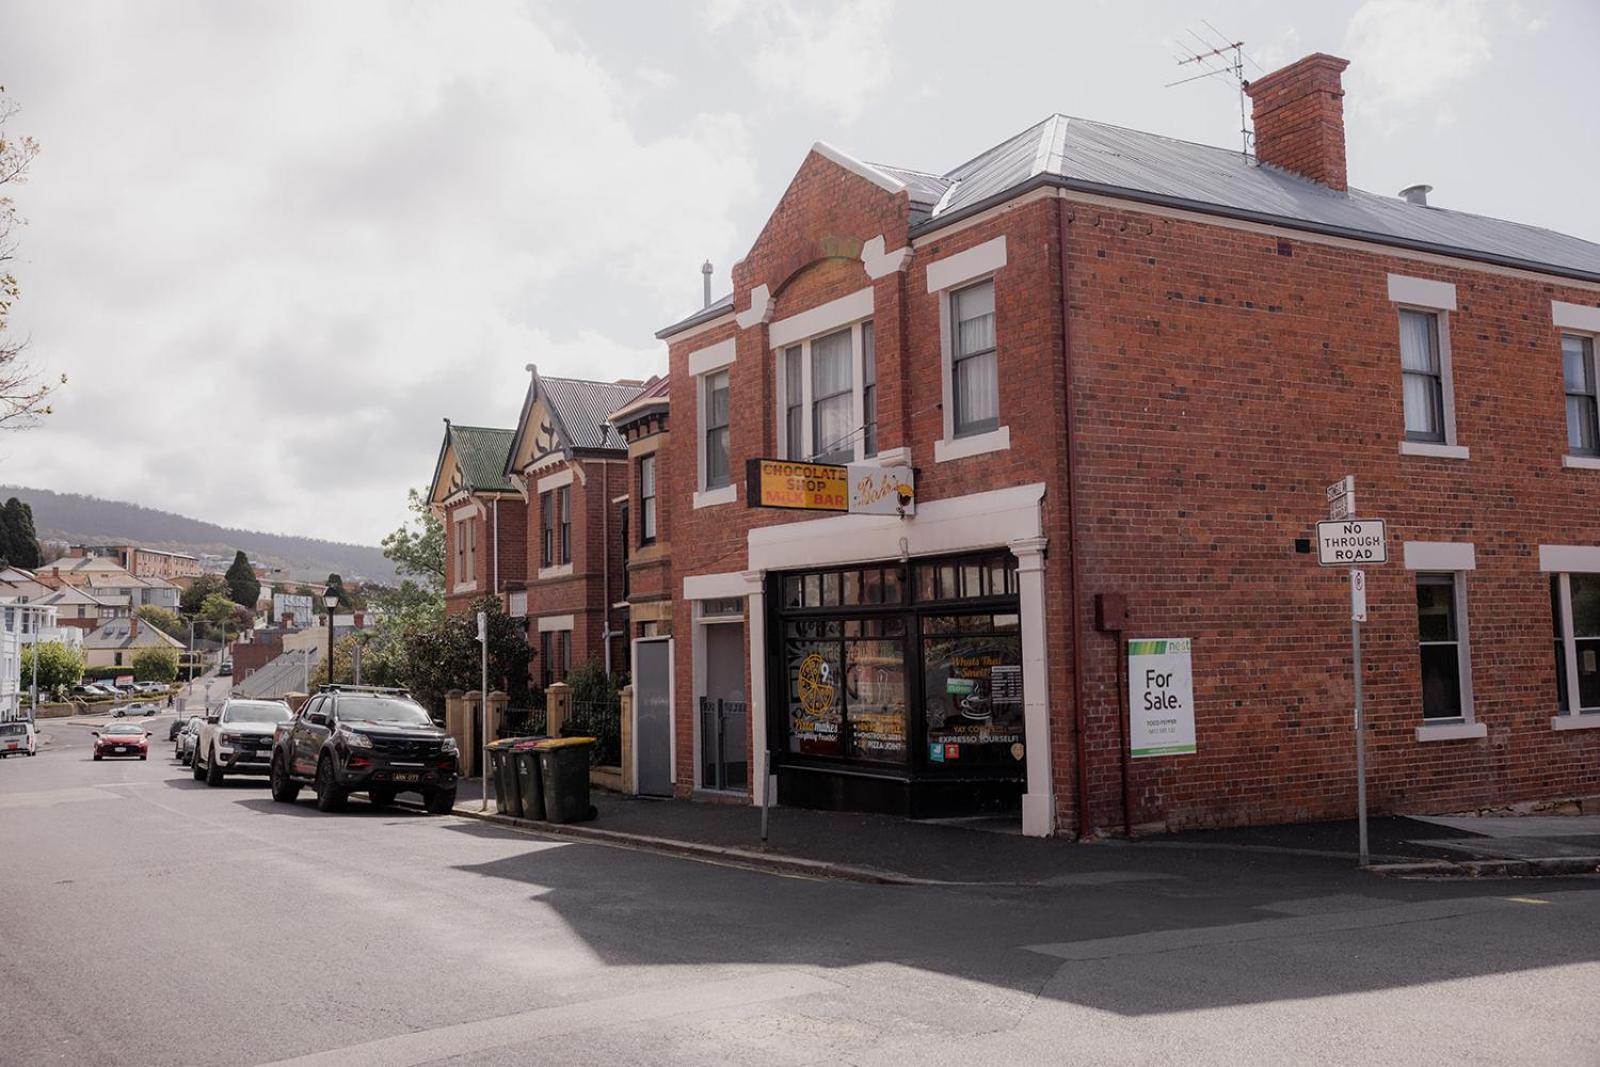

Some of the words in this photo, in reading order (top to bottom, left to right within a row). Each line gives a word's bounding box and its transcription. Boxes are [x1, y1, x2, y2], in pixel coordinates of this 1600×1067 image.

[763, 464, 847, 481] CHOCOLATE
[786, 478, 827, 492] SHOP
[765, 491, 806, 505] MILK
[814, 494, 844, 506] BAR
[1344, 524, 1362, 535] NO
[1324, 537, 1380, 548] THROUGH
[1335, 549, 1373, 560] ROAD
[1169, 639, 1190, 651] nest
[1146, 669, 1172, 689] For
[1144, 691, 1182, 711] Sale.
[938, 735, 977, 744] EXPRESSO
